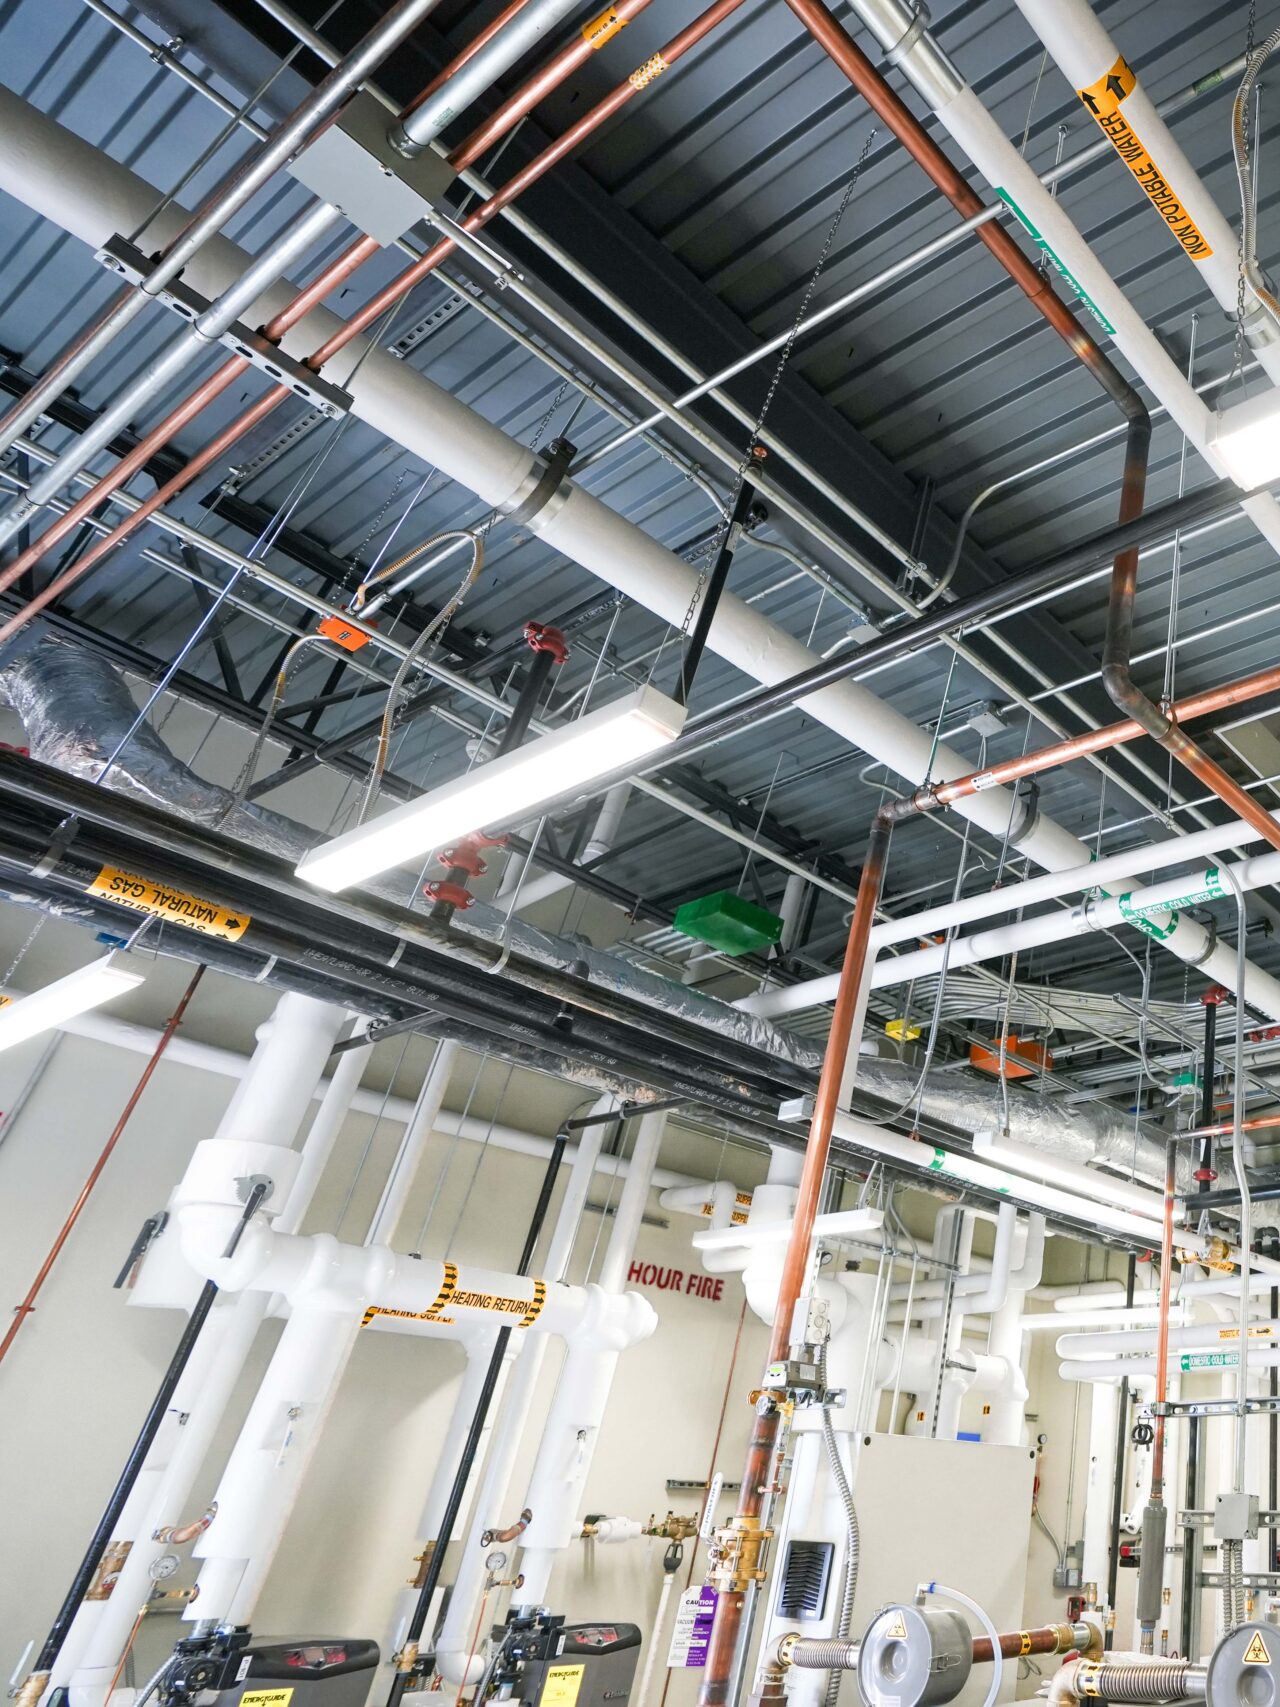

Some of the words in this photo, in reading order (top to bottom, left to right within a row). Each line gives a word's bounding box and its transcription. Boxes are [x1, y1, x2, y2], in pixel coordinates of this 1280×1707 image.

[1100, 111, 1145, 163] WATER
[1133, 162, 1187, 224] POTABLE
[1174, 224, 1208, 256] NON
[110, 876, 146, 898] GAS
[153, 889, 218, 924] NATURAL
[1134, 903, 1169, 919] DOMESTIC
[1170, 898, 1190, 910] COLD
[627, 1260, 684, 1293] HOUR
[685, 1273, 725, 1302] FIRE
[450, 1290, 492, 1310] HEATING
[492, 1297, 532, 1315] RETURN
[243, 1694, 287, 1705] ENERGYGUIDE
